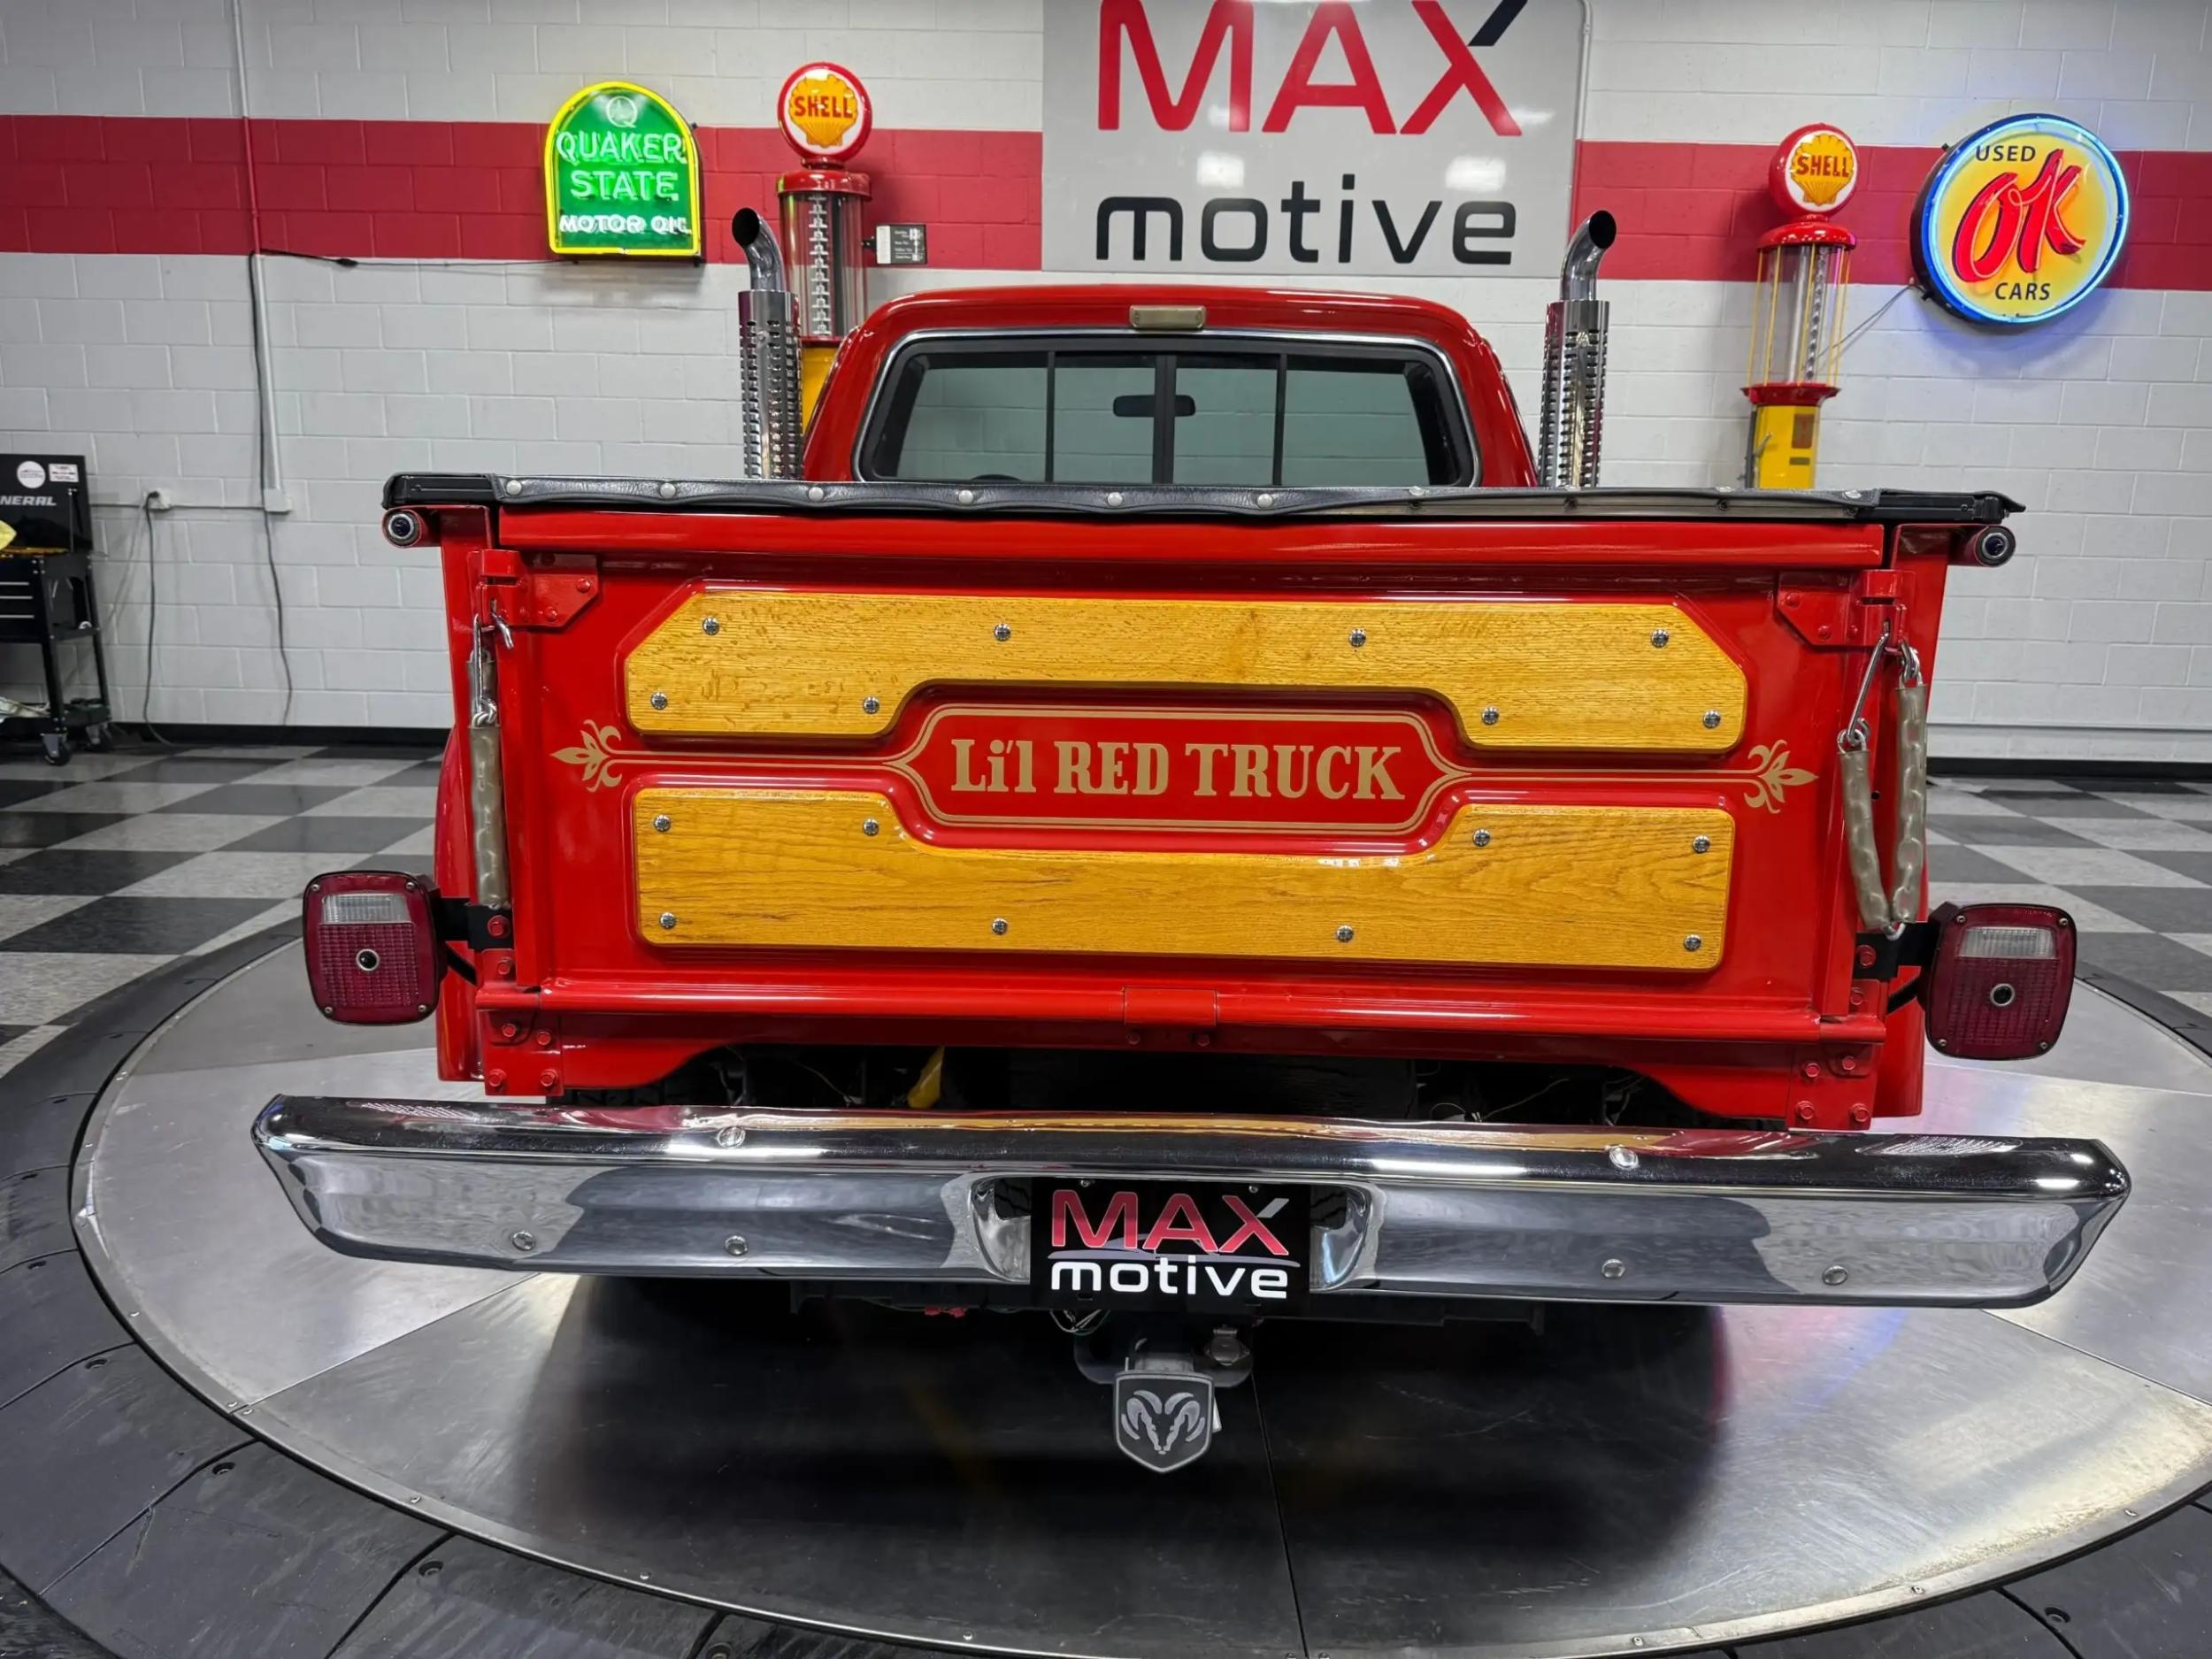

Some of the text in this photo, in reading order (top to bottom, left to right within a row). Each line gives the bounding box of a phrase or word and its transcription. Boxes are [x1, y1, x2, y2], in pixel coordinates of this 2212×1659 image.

[1097, 0, 1527, 137] MAX
[793, 95, 854, 119] SHELL
[556, 130, 687, 166] QUAKER
[1975, 144, 2037, 163] USED
[1795, 154, 1850, 179] SHELL
[570, 170, 680, 201] STATE
[559, 213, 693, 234] MOTOR OIL
[1095, 173, 1517, 265] motive
[1952, 149, 2086, 283] OK
[1994, 281, 2052, 301] CARS
[1053, 741, 1170, 796] RED
[1185, 742, 1406, 800] TRUCK
[1051, 1189, 1290, 1256] MAX
[1050, 1255, 1288, 1299] motive
